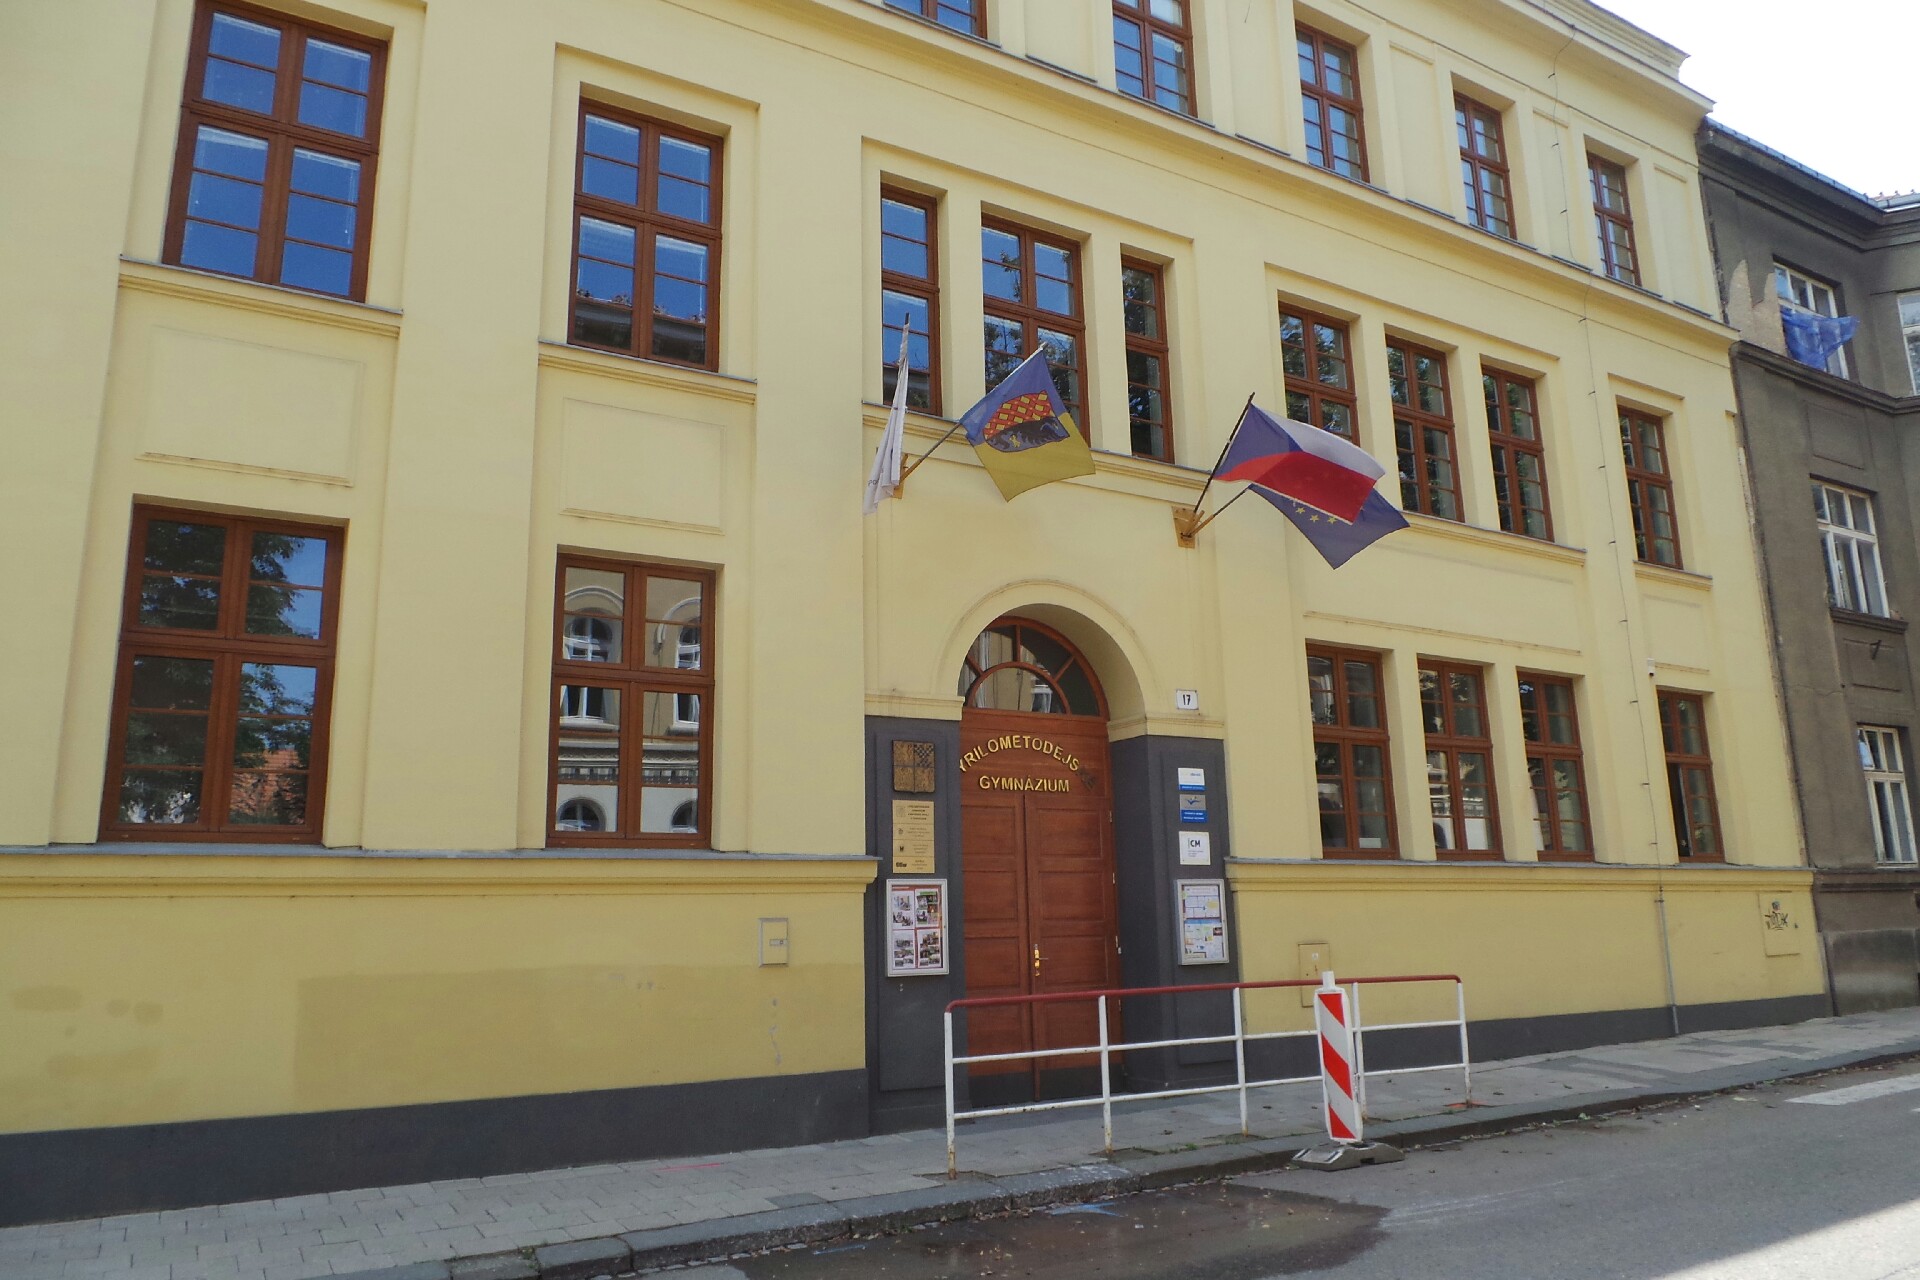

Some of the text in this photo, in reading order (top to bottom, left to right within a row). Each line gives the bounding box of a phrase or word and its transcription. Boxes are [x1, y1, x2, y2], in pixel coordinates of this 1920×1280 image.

[1182, 694, 1191, 706] 17
[959, 735, 1093, 784] YRILOMETODEJS
[979, 774, 1070, 793] GYMNÁZIUM
